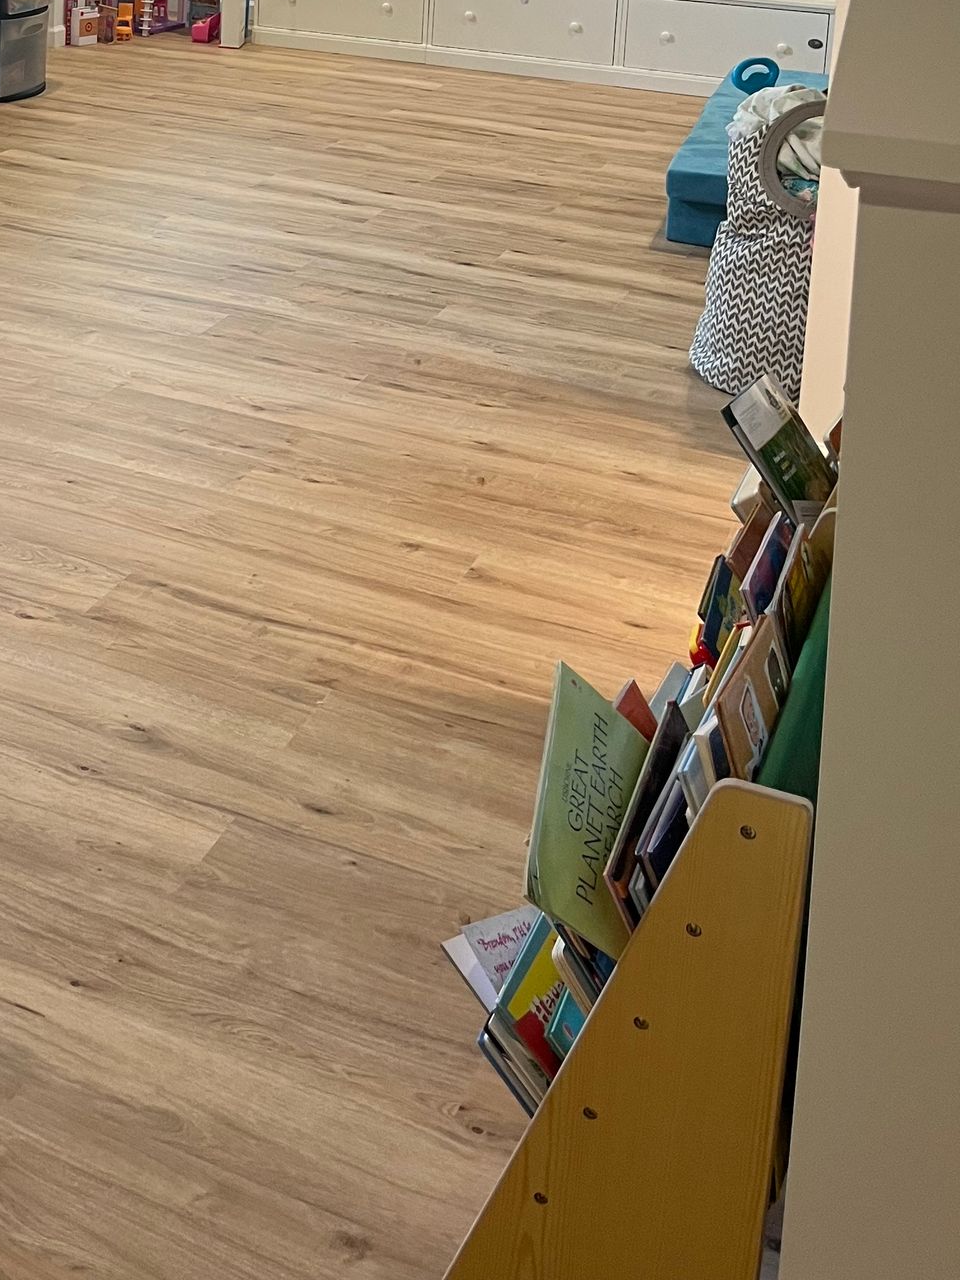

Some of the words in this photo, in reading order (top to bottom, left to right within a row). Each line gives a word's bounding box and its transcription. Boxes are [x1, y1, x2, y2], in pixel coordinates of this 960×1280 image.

[567, 748, 589, 832] GREAT
[575, 795, 605, 906] PLANET
[590, 711, 609, 798] EARTH
